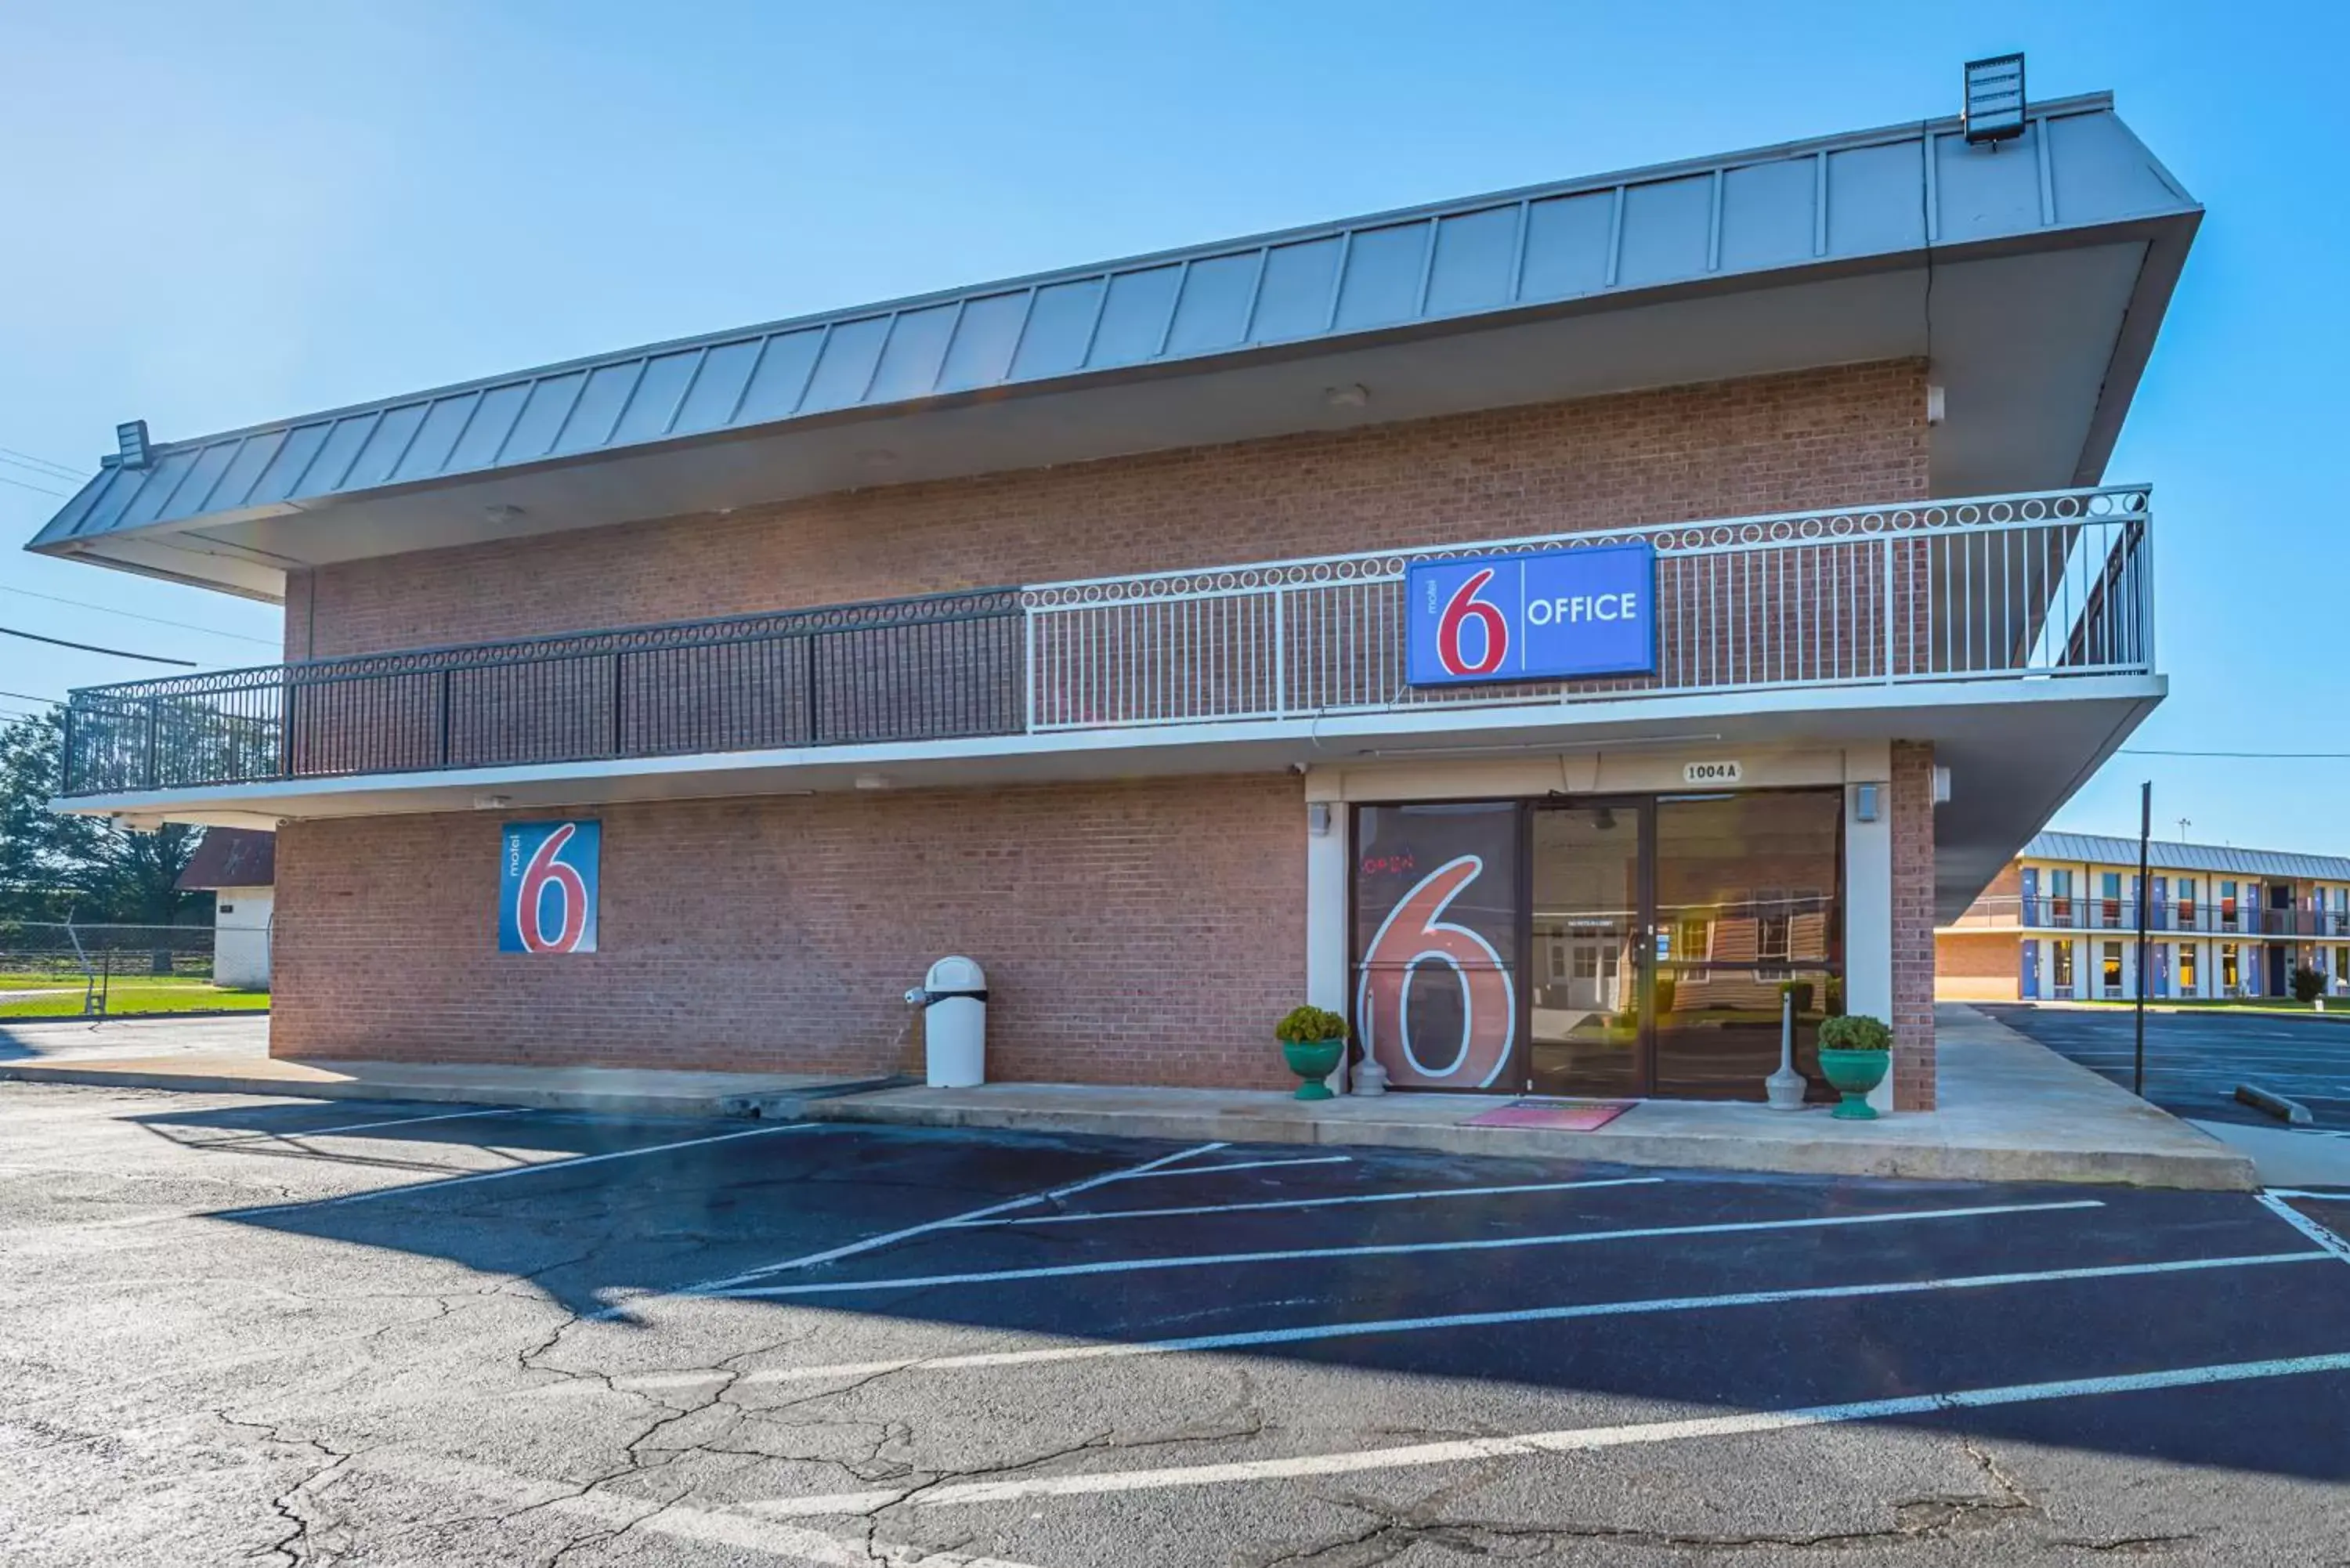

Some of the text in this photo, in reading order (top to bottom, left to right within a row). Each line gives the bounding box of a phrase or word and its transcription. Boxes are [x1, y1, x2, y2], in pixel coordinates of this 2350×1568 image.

[1428, 567, 1509, 676] motel 6
[1528, 593, 1637, 626] OFFICE
[1689, 764, 1736, 779] 1004A
[508, 822, 588, 953] motel 6
[1356, 854, 1516, 1088] 6
